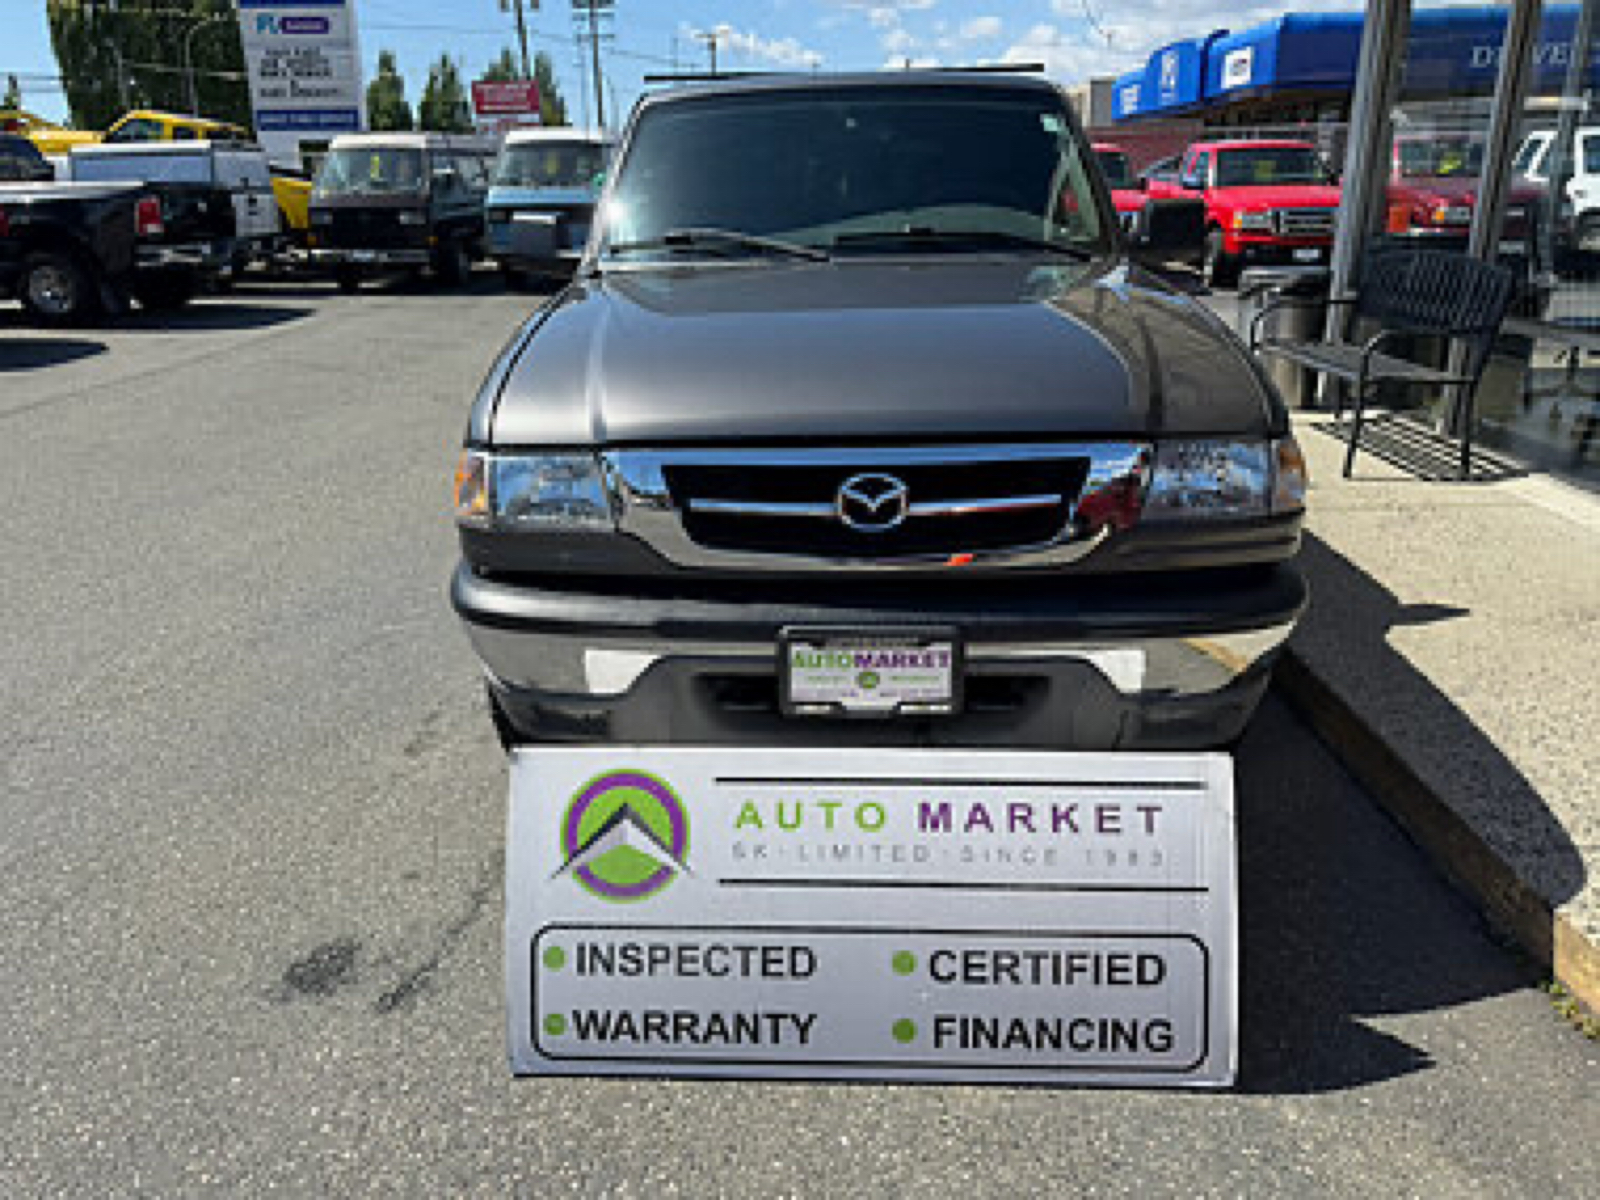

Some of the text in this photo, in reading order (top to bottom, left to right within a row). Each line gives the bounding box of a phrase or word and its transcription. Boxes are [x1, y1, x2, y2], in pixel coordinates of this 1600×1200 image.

[791, 650, 950, 669] AUTOMARKET
[734, 801, 1164, 833] AUTO MARKET
[577, 945, 817, 980] INSPECTED
[929, 951, 1166, 986] CERTIFIED
[574, 1011, 818, 1045] WARRANTY
[934, 1018, 1174, 1052] FINANCING
